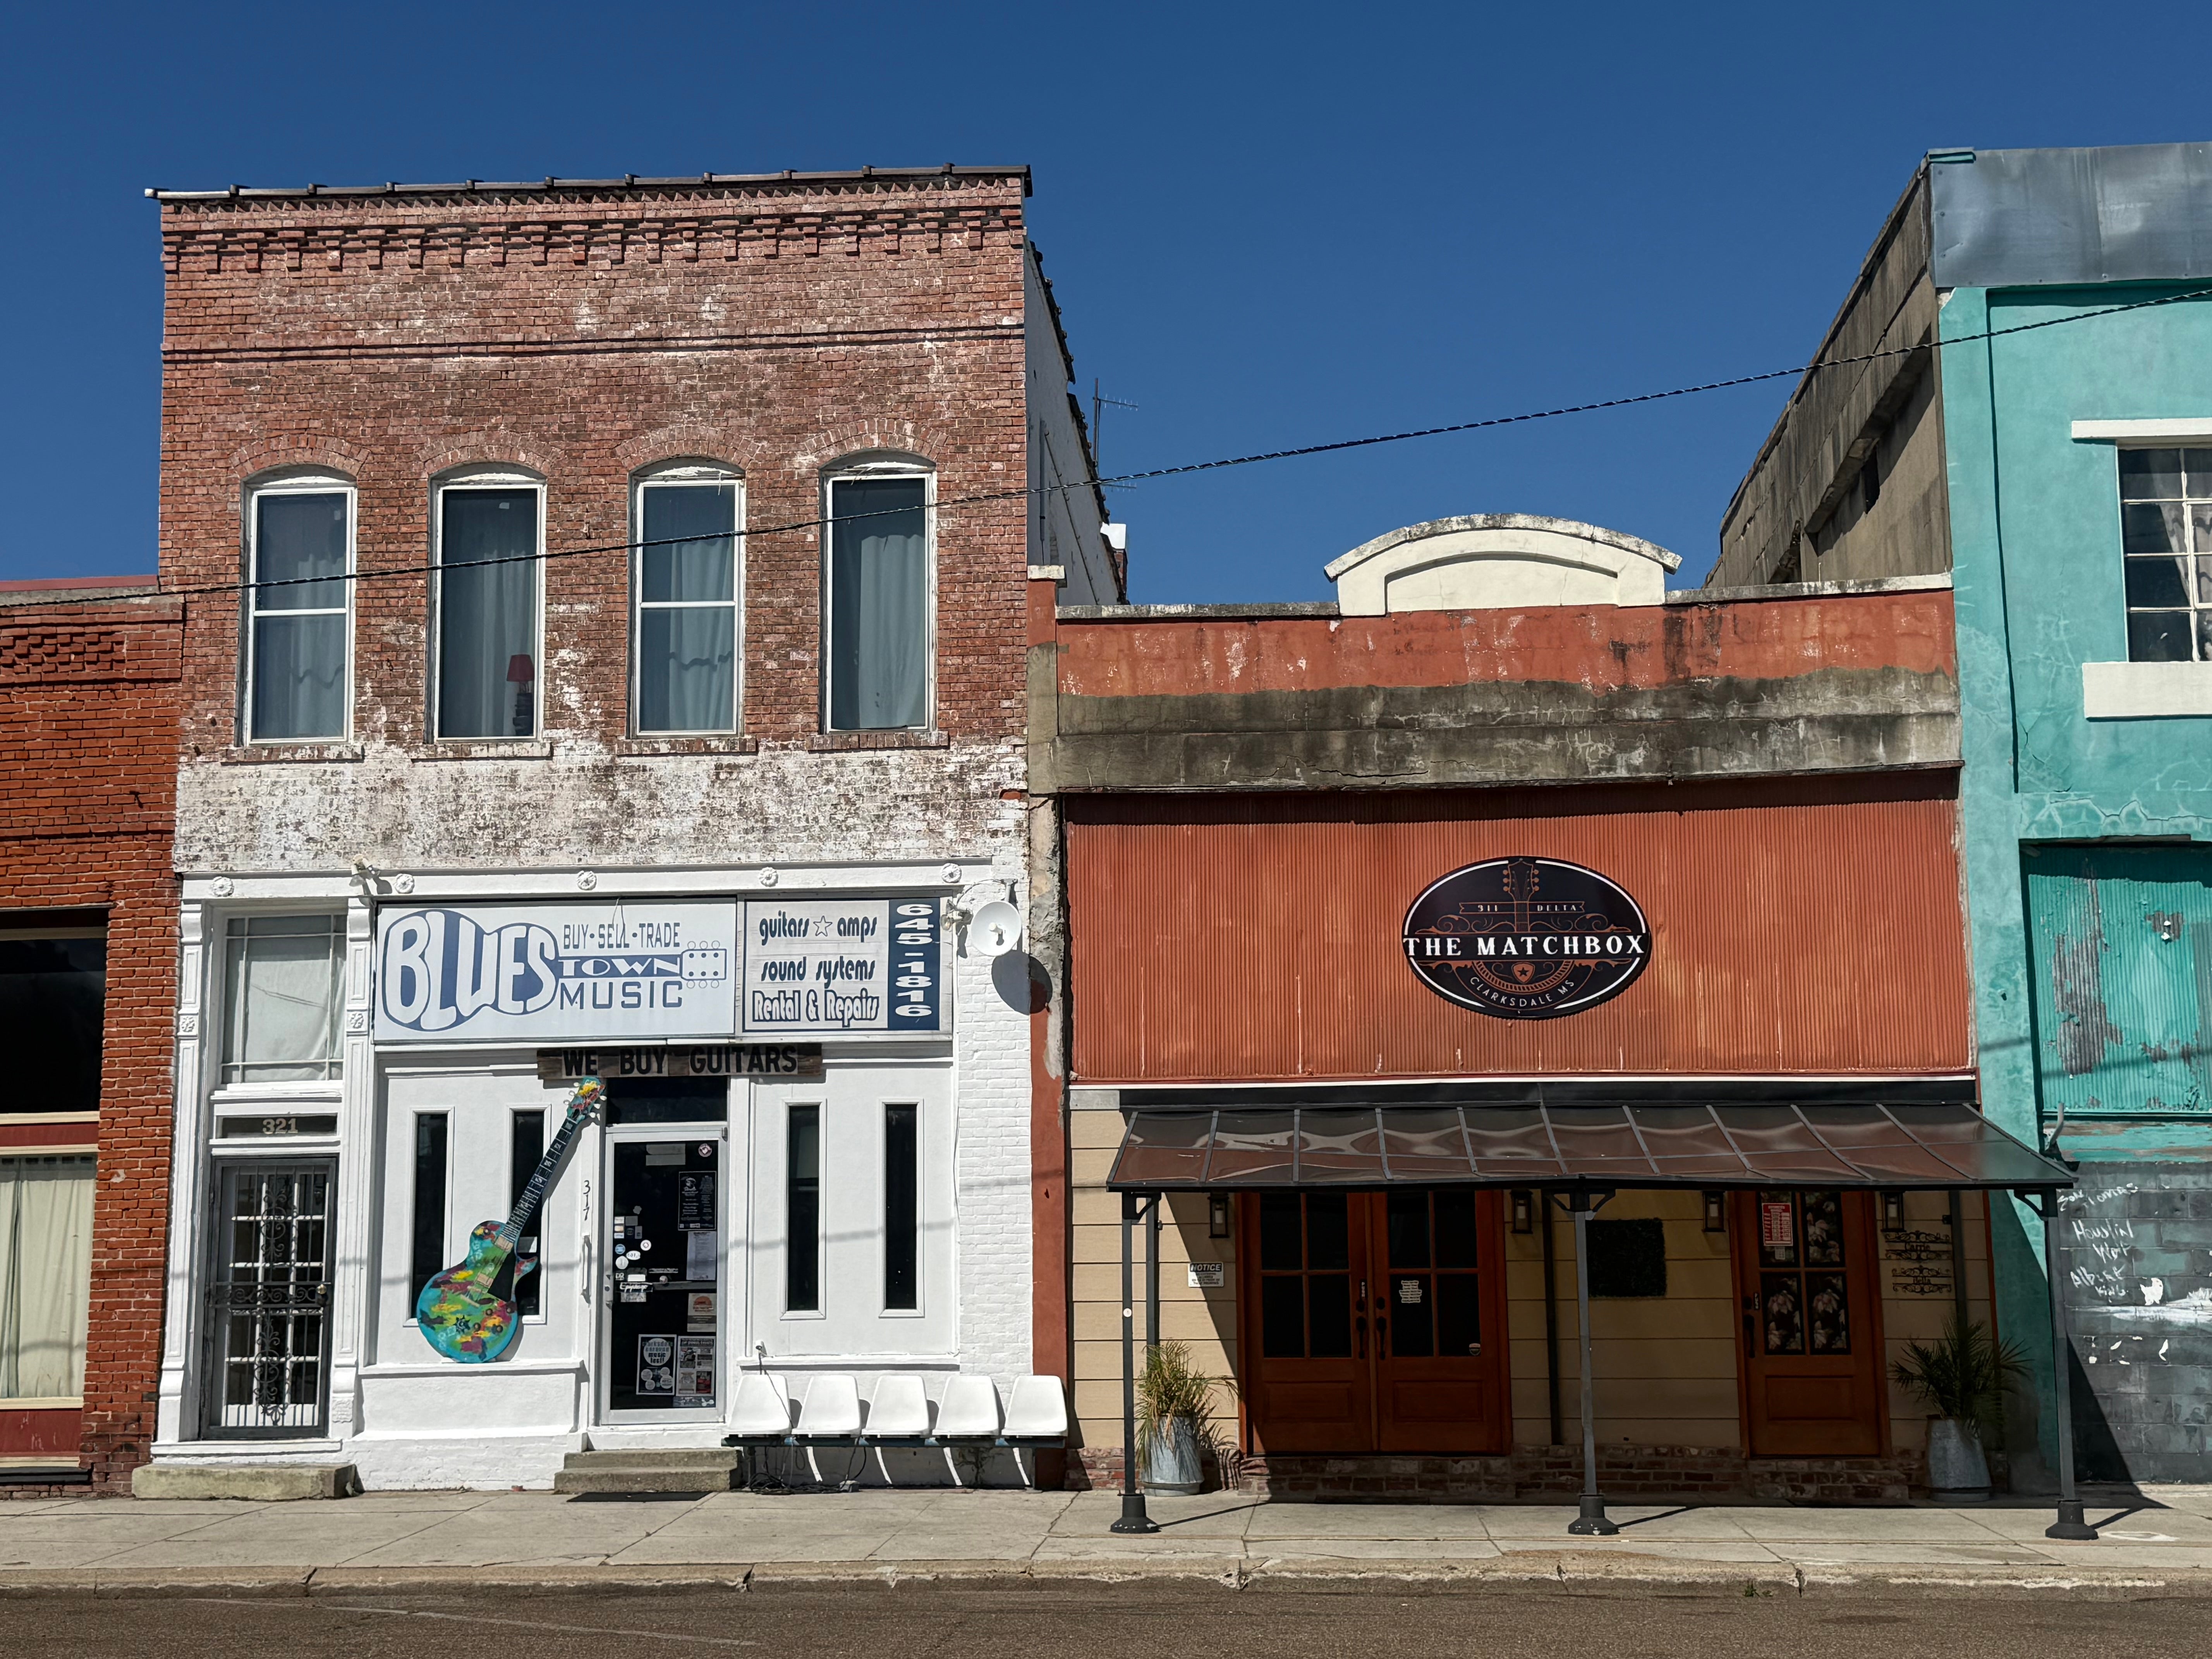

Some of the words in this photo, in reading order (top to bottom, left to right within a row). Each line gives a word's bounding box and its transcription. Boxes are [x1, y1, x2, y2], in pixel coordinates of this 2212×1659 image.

[563, 924, 589, 949] BUY
[598, 923, 630, 948] SELL
[639, 922, 680, 948] TRADE
[759, 910, 810, 946] guitars
[837, 916, 877, 943] amps
[1403, 937, 1461, 956] THE
[1477, 934, 1644, 956] MATCHBOX
[385, 911, 556, 1030] BLUES
[558, 957, 680, 976] TOWN
[761, 956, 807, 981] sound
[816, 956, 876, 989] systems
[895, 904, 934, 1017] 645-1816
[560, 981, 683, 1010] MUSIC
[1470, 977, 1553, 1007] CLARKSDALE
[1558, 979, 1574, 995] MS
[752, 989, 801, 1022] Rental
[806, 989, 820, 1022] &
[825, 988, 879, 1027] Repairs
[563, 1050, 598, 1076] WE
[620, 1048, 667, 1075] BUY
[690, 1046, 797, 1074] GUITARS
[263, 1118, 298, 1134] 321
